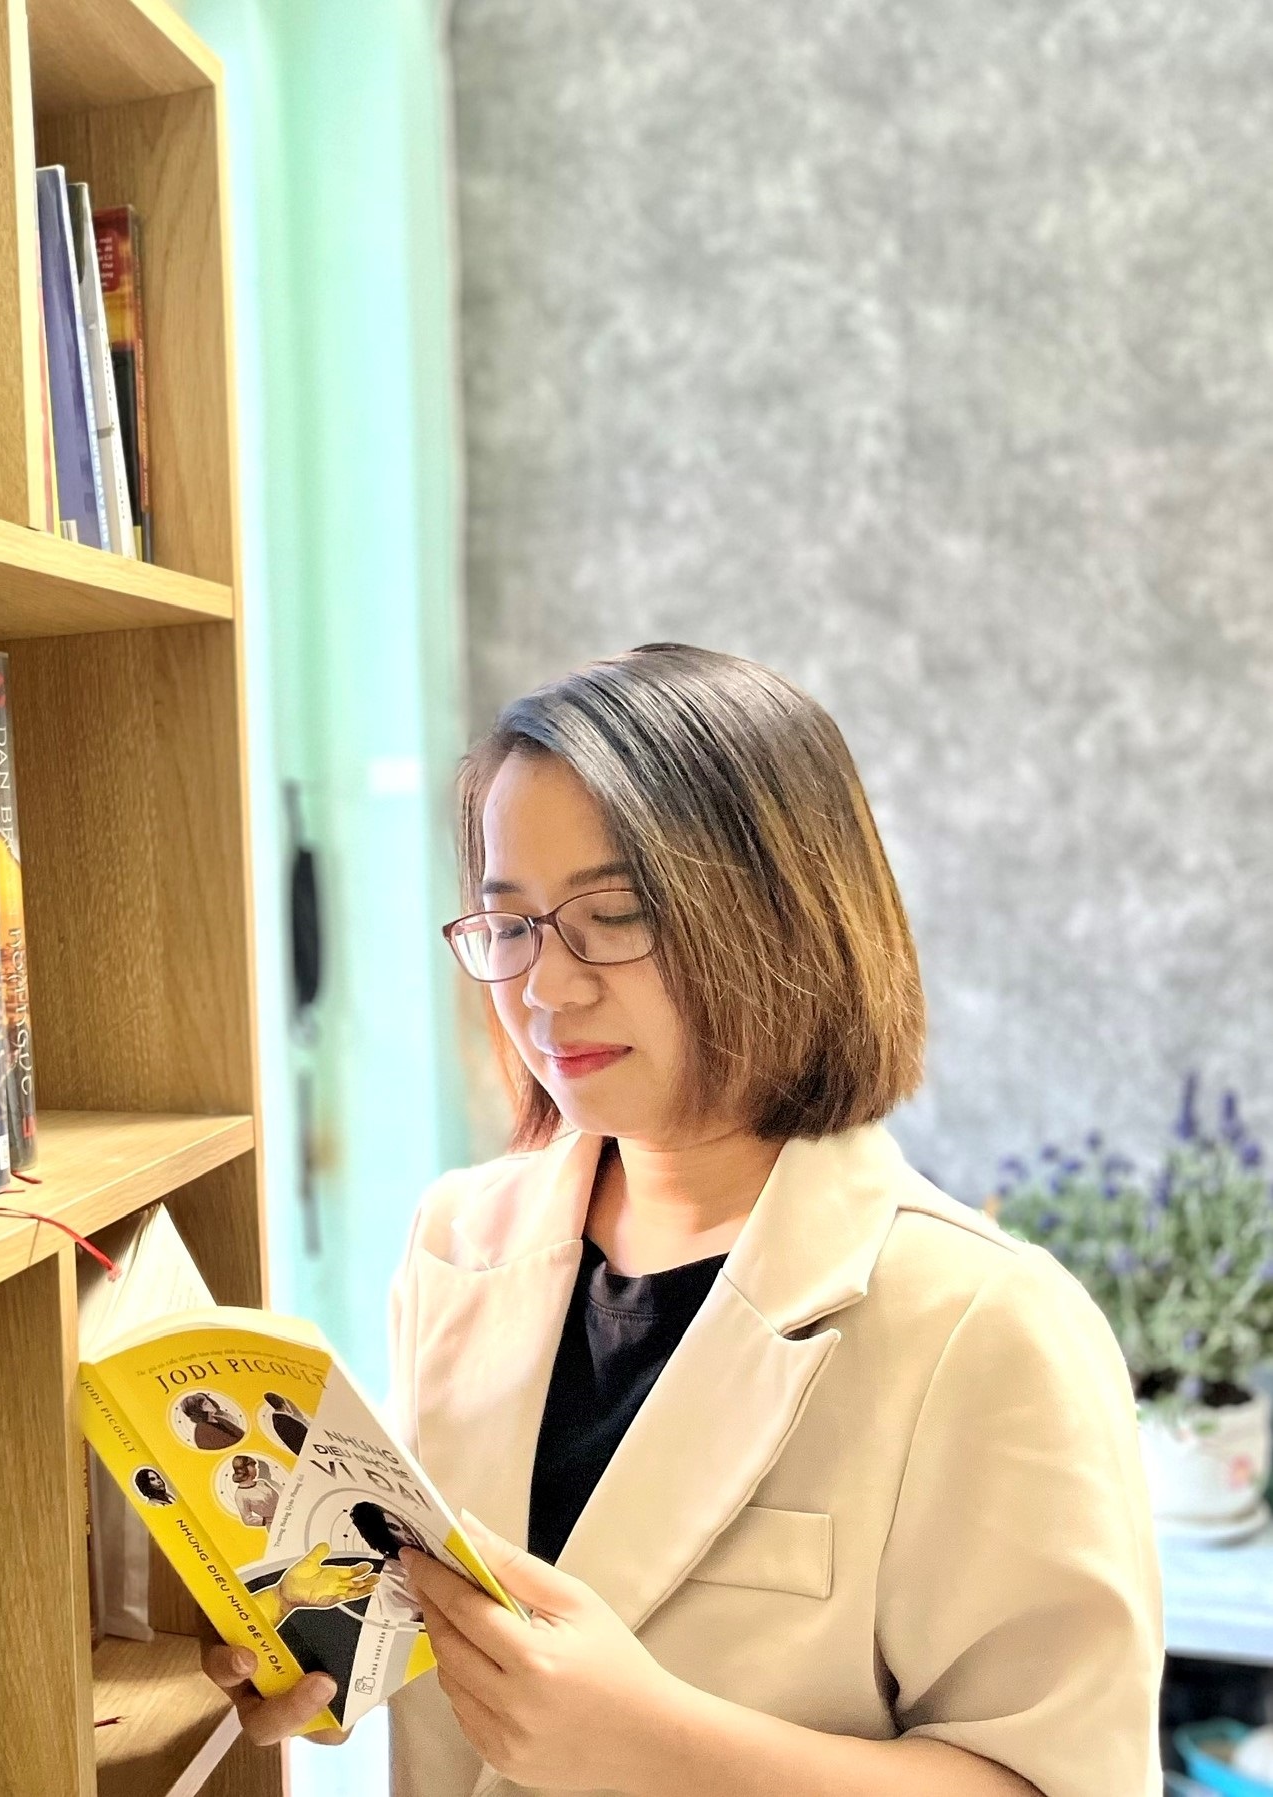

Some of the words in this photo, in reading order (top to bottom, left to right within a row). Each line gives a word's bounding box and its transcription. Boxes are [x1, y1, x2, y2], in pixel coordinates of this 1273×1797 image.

[155, 1360, 222, 1395] JODI
[225, 1357, 328, 1391] PICOULT
[80, 1380, 104, 1406] JODI
[100, 1407, 137, 1453] PICOULT
